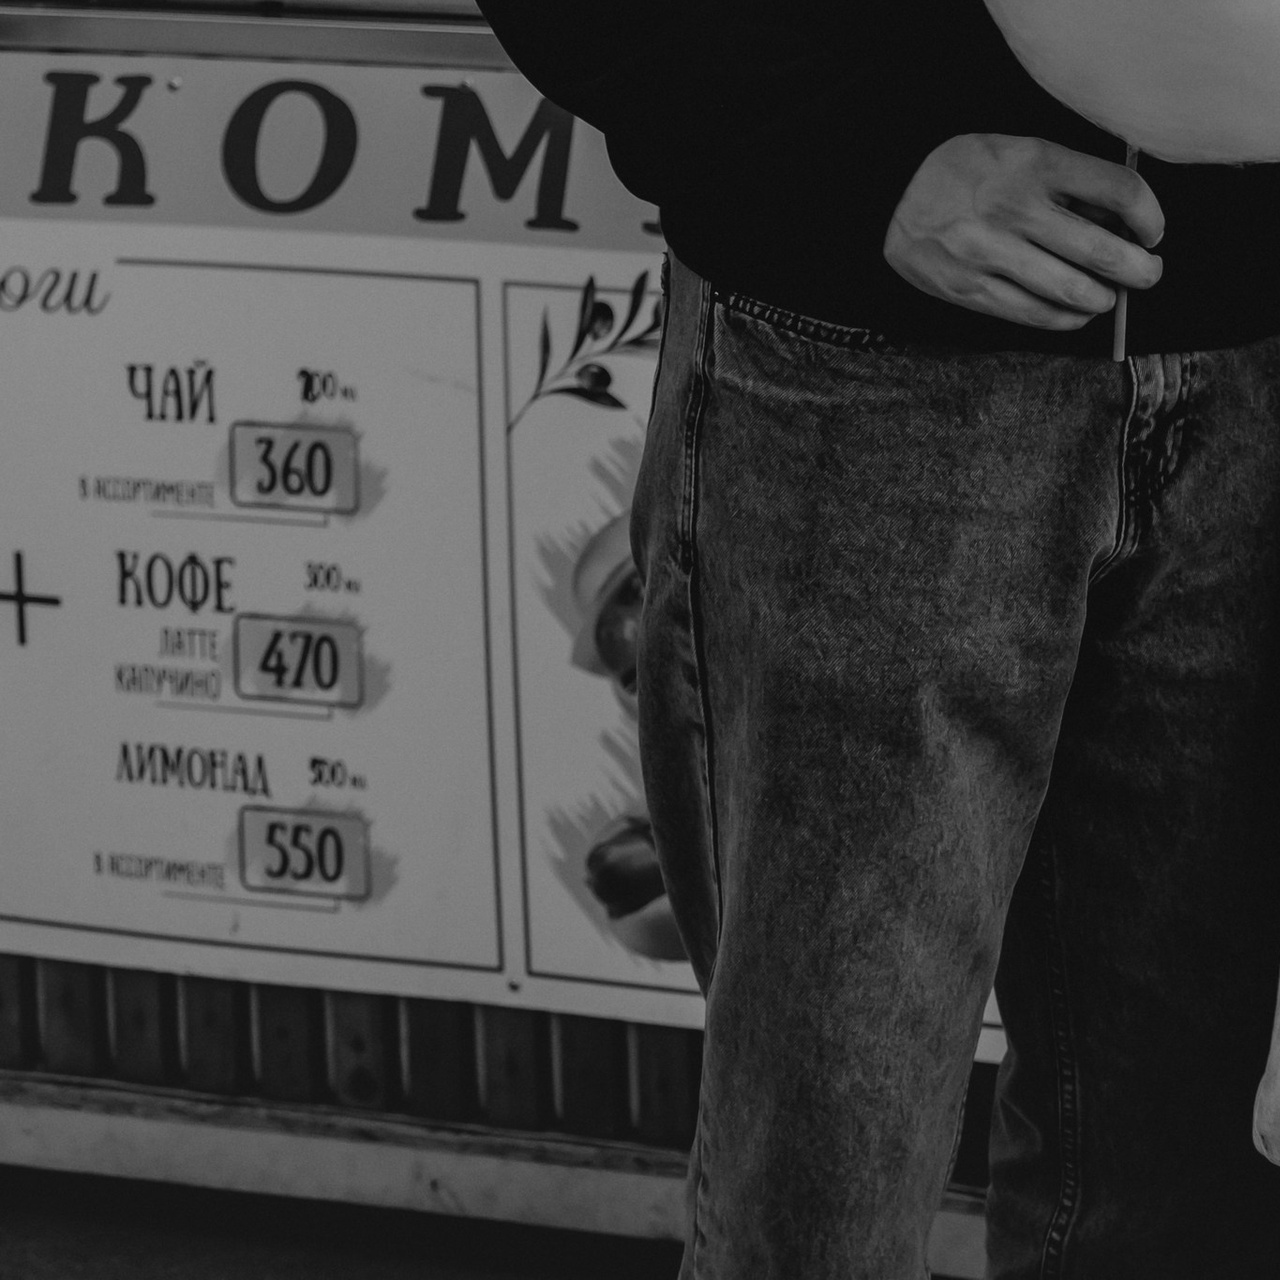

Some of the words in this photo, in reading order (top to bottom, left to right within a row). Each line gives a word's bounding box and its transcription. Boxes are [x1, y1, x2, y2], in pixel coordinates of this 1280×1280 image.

[30, 71, 662, 233] КОМ
[126, 360, 216, 424] ЧАЙ
[255, 436, 333, 497] 360
[116, 550, 237, 614] КОФЕ
[259, 628, 341, 691] 470
[116, 741, 273, 799] ЛИМОНАД
[265, 821, 345, 882] 550
